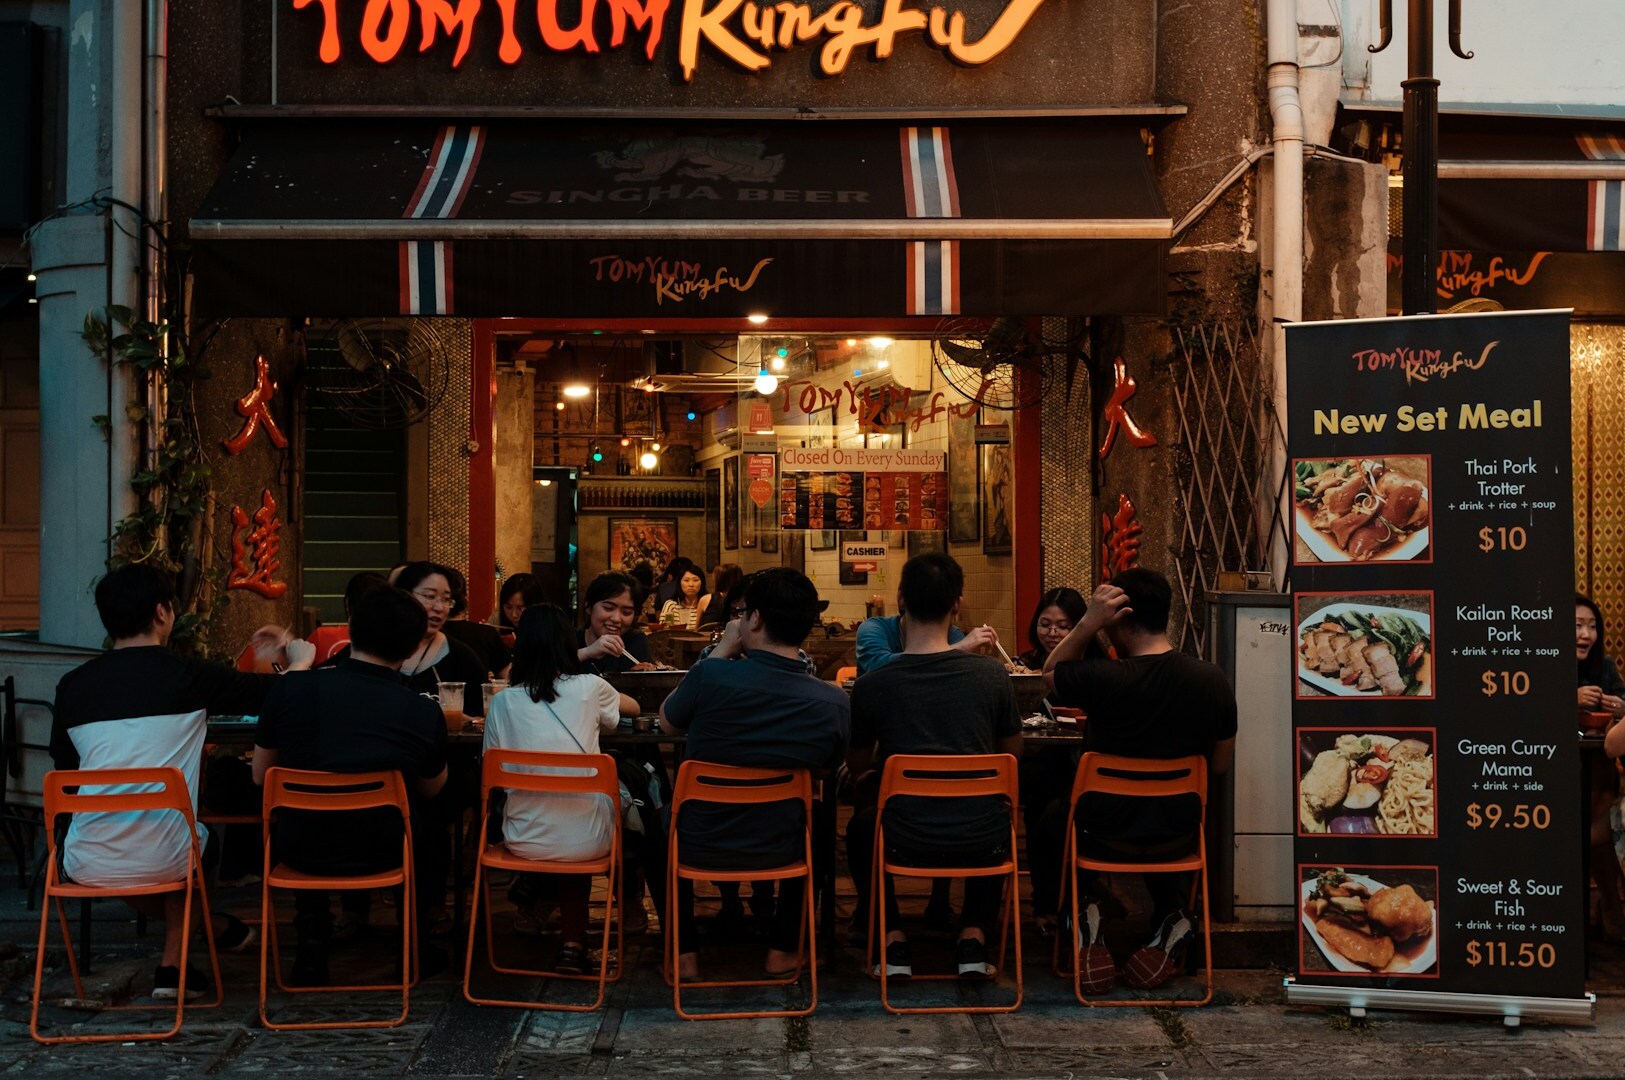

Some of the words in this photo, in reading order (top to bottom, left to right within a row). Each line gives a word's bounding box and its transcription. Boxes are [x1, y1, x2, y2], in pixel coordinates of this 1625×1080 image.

[505, 184, 723, 204] SINGHA
[737, 190, 871, 203] BEER
[1314, 409, 1387, 434] New
[1397, 406, 1447, 431] Set
[1459, 400, 1541, 429] Meal
[783, 449, 829, 466] Closed
[833, 449, 853, 465] On
[857, 450, 892, 469] Every
[895, 450, 944, 470] Sunday
[1465, 459, 1497, 475] Thai
[1504, 457, 1537, 474] Pork
[1478, 481, 1525, 495] Trotter
[1459, 501, 1483, 510] drink
[1533, 502, 1556, 510] soup
[1479, 526, 1526, 552] $10
[846, 547, 885, 556] CASHIER
[1457, 604, 1505, 620] Kailan
[1511, 605, 1553, 620] Roast
[1488, 625, 1521, 641] Pork
[1462, 647, 1487, 655] drink
[1502, 647, 1520, 655] rice
[1536, 649, 1559, 657] soup
[1482, 670, 1529, 696] $10
[1458, 739, 1506, 754] Green
[1512, 740, 1556, 759] Curry
[1482, 762, 1532, 776] Mama
[1483, 781, 1508, 790] drink
[1524, 782, 1543, 791] side
[1467, 803, 1550, 829] $9.50
[1457, 878, 1503, 894] Sweet
[1508, 879, 1521, 894] &
[1527, 880, 1562, 895] Sour
[1495, 899, 1524, 916] Fish
[1467, 920, 1491, 929] drink
[1508, 922, 1525, 930] rice
[1541, 925, 1565, 934] soup
[1467, 940, 1555, 967] $11.50
